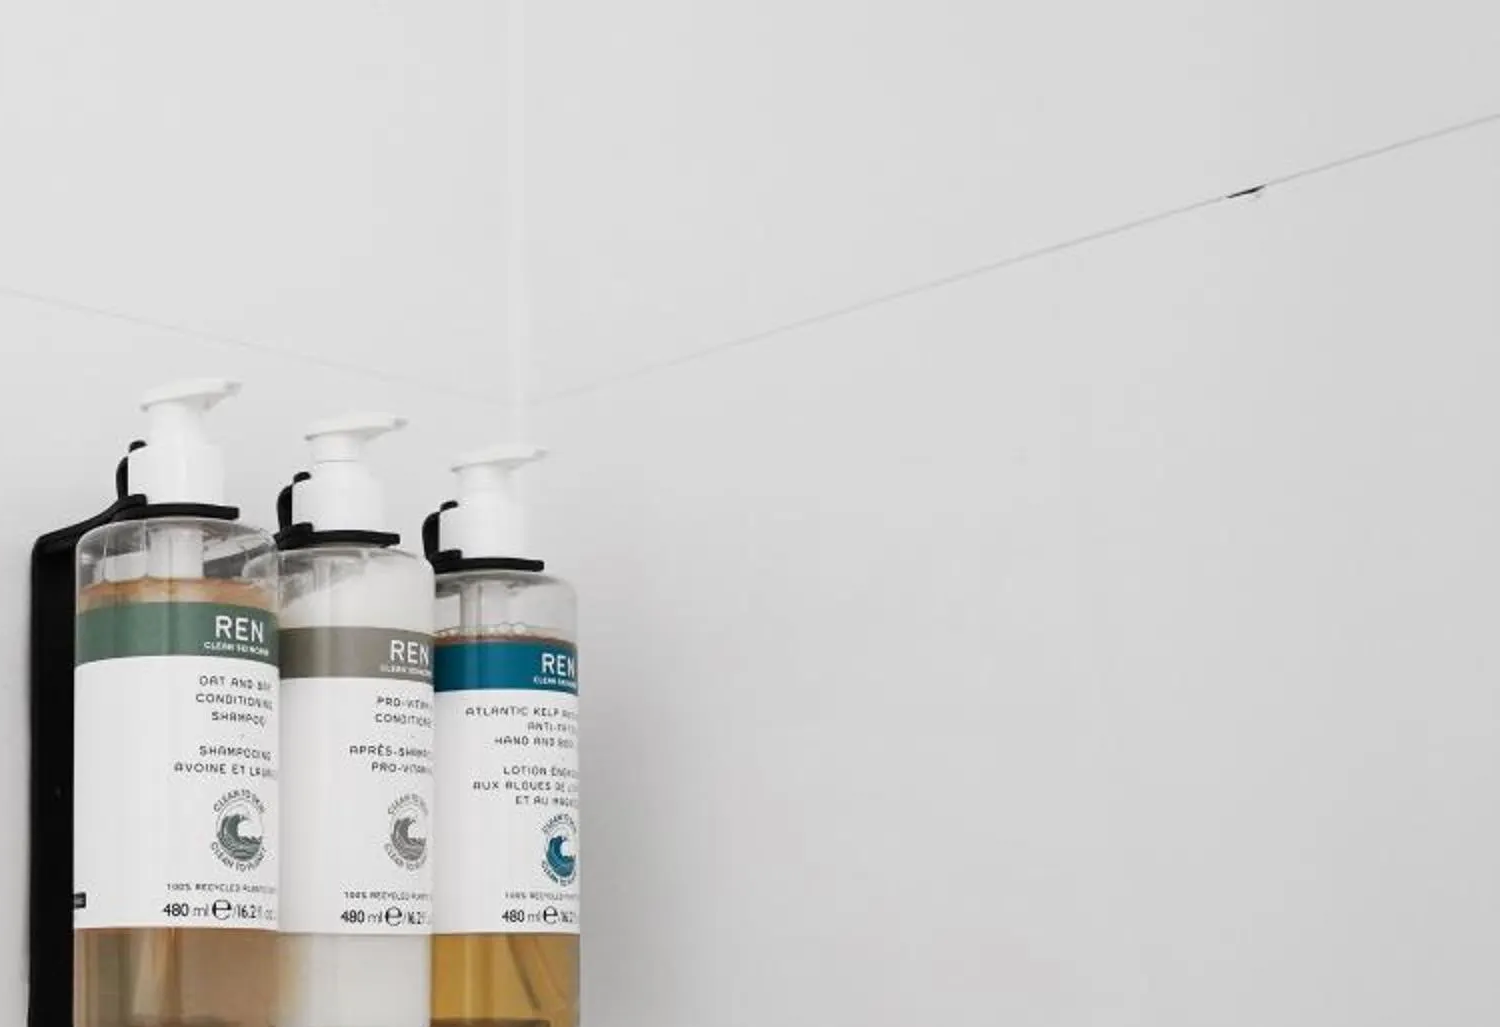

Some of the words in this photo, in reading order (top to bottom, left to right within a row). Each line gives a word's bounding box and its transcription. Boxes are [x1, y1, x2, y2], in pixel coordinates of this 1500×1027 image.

[215, 615, 264, 643] REN
[390, 639, 429, 667] REN
[541, 653, 575, 679] REN
[199, 675, 225, 687] OAT
[231, 677, 253, 690] AND
[465, 706, 528, 718] ATLANTIC
[533, 707, 559, 718] KELP
[494, 735, 529, 747] HAND
[173, 762, 227, 775] AVOINE
[231, 764, 245, 775] ET
[502, 764, 547, 776] LOTION
[472, 780, 499, 791] AUX
[515, 795, 529, 805] ET
[533, 796, 549, 805] AU
[163, 903, 190, 917] 480
[193, 903, 209, 917] ml
[340, 909, 365, 924] 480
[367, 910, 383, 924] ml
[501, 909, 525, 922] 480
